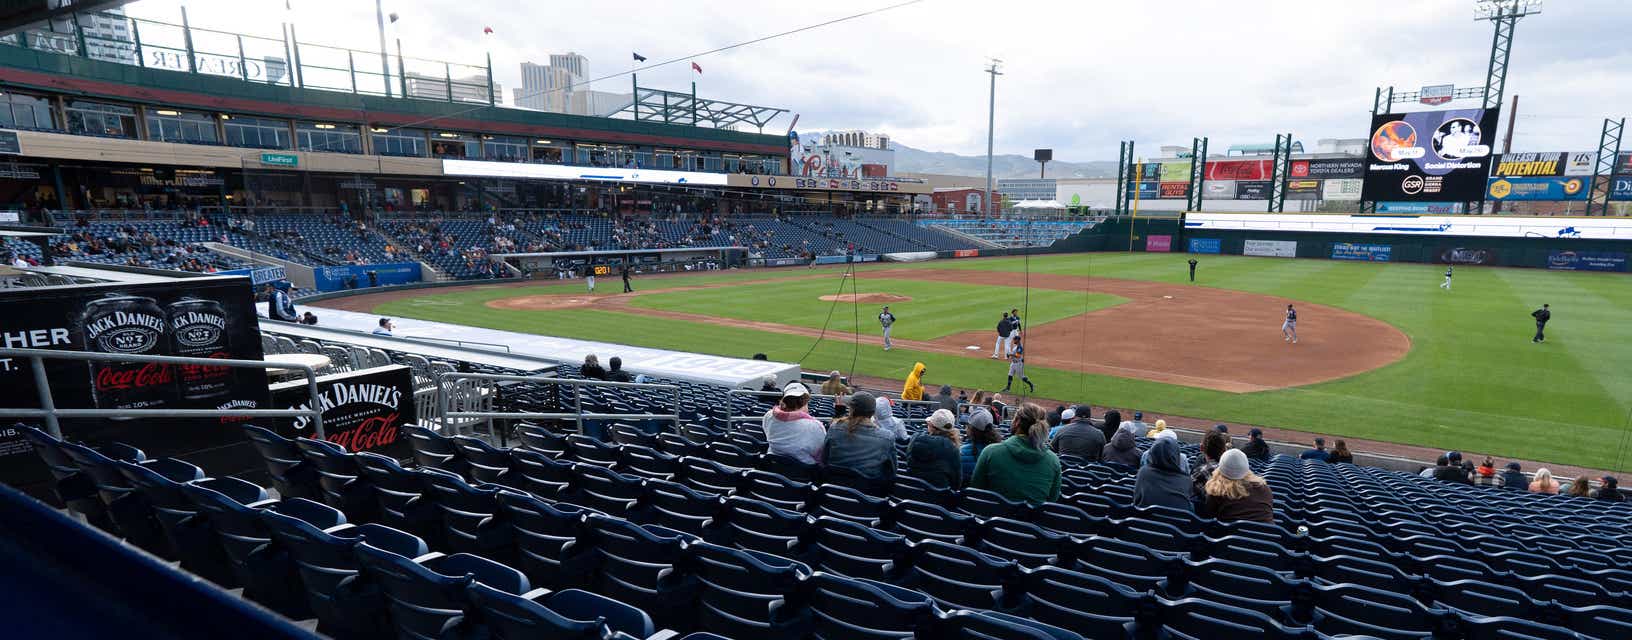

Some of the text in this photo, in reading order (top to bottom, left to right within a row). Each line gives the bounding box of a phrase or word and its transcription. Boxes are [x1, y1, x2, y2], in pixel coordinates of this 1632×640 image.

[1501, 153, 1561, 162] UNLEASH YOUR
[1394, 163, 1410, 171] King
[1446, 161, 1481, 169] Distortion
[1496, 161, 1558, 175] POTENTIAL
[1404, 180, 1421, 189] GSR
[252, 268, 286, 283] GREATER
[86, 311, 164, 339] JACK DANIEL'S
[188, 311, 226, 330] DANIEL'S
[0, 327, 72, 350] HER
[332, 382, 402, 410] DANIEL'S
